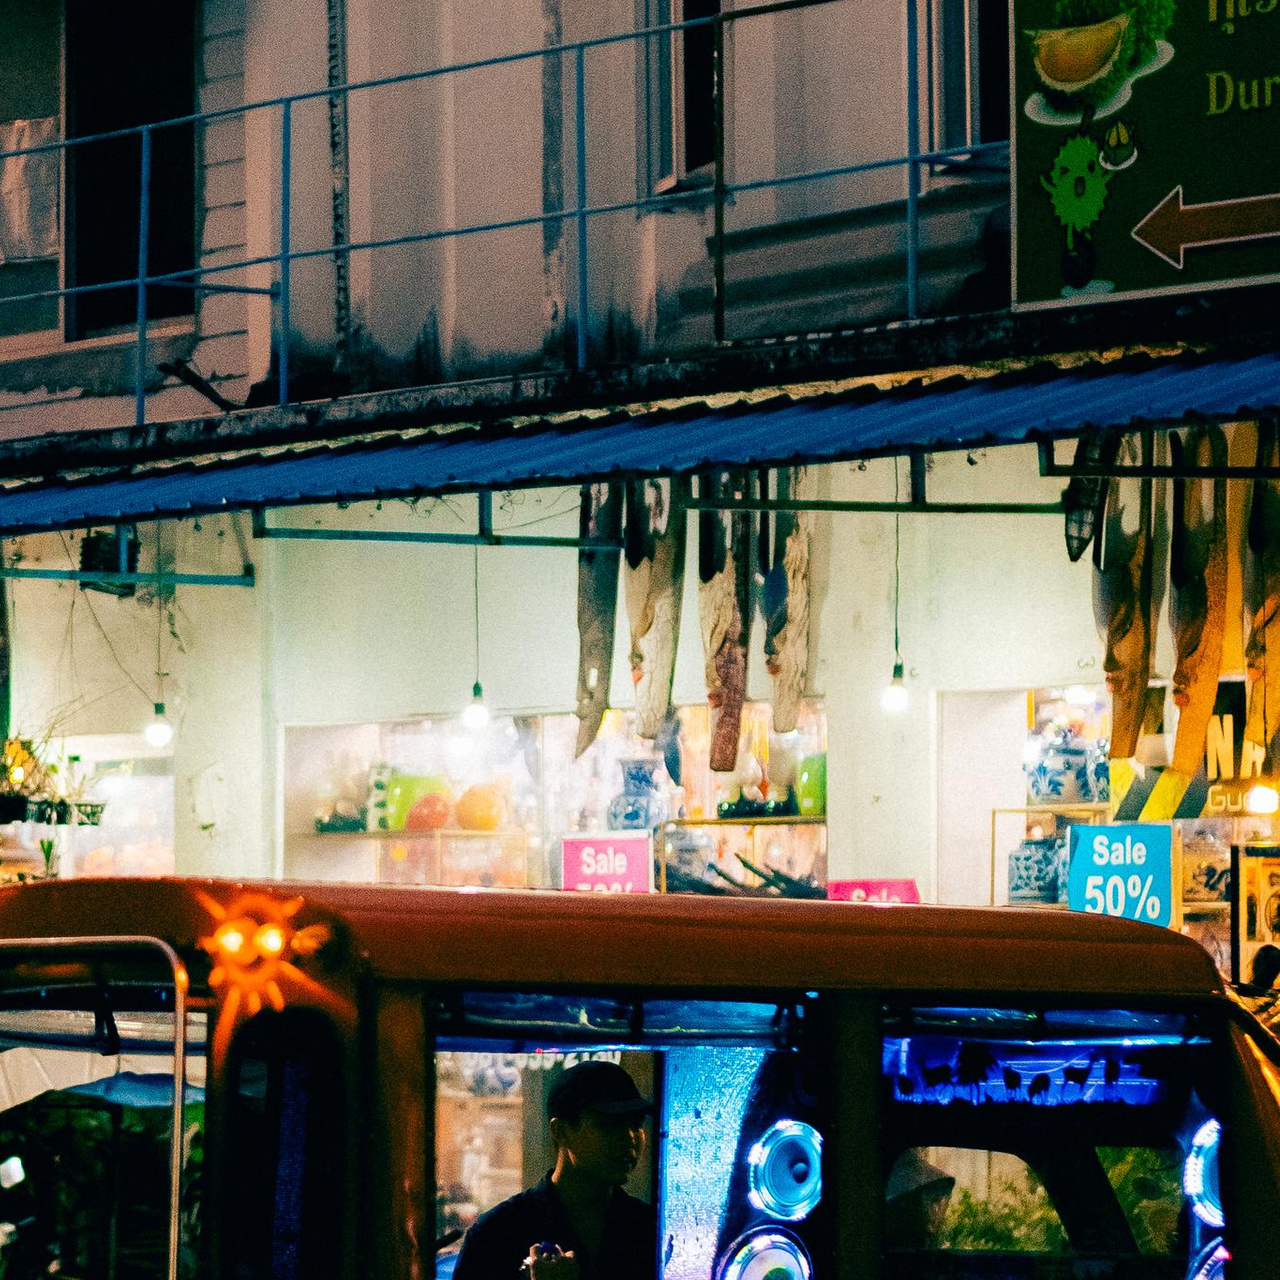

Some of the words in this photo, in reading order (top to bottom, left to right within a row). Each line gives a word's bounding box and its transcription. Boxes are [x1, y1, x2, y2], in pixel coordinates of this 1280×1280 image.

[580, 846, 627, 876] Sale
[1092, 834, 1148, 866] Sale
[1084, 874, 1161, 920] 50%
